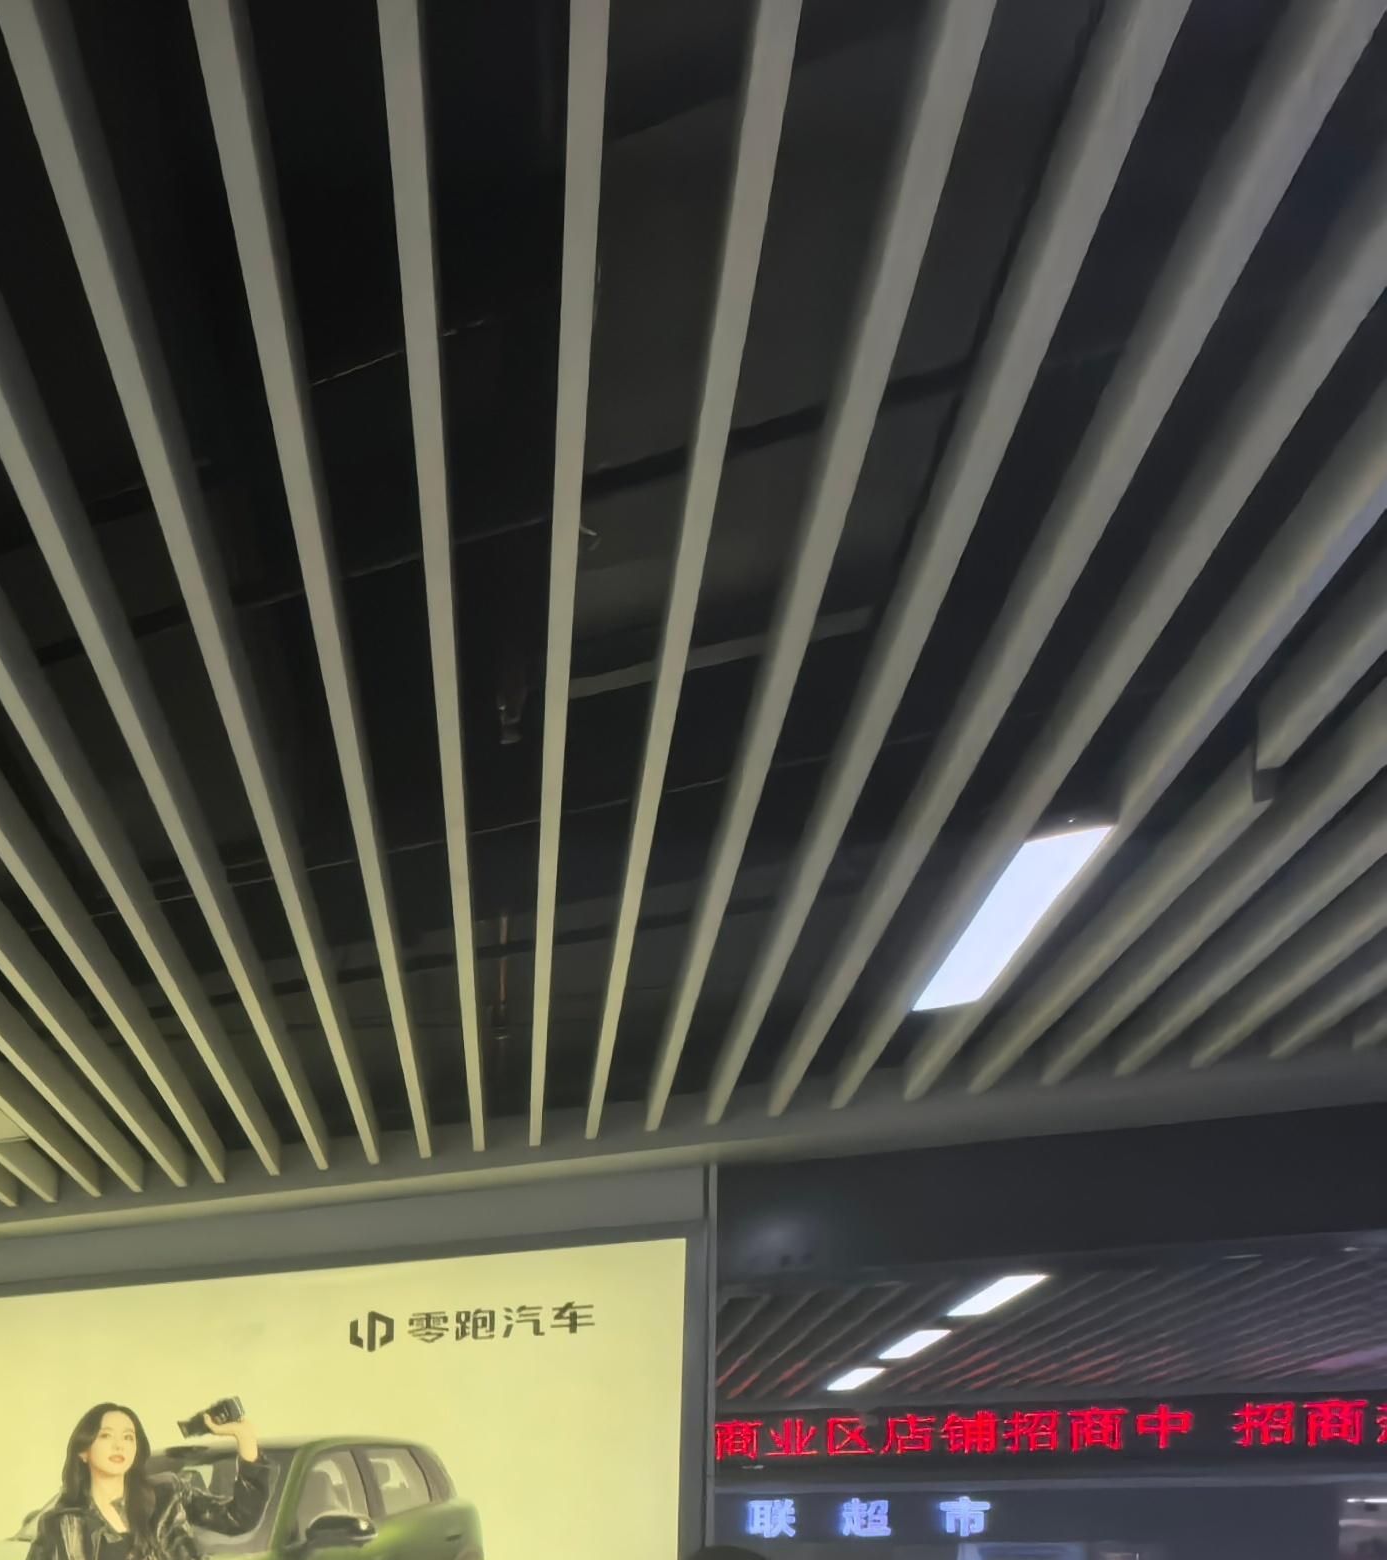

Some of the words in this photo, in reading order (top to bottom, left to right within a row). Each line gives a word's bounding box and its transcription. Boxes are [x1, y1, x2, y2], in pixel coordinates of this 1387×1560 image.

[407, 1300, 596, 1343] 零跑汽车
[714, 1403, 1194, 1461] 商业区店铺招商中
[1231, 1397, 1387, 1447] 招商
